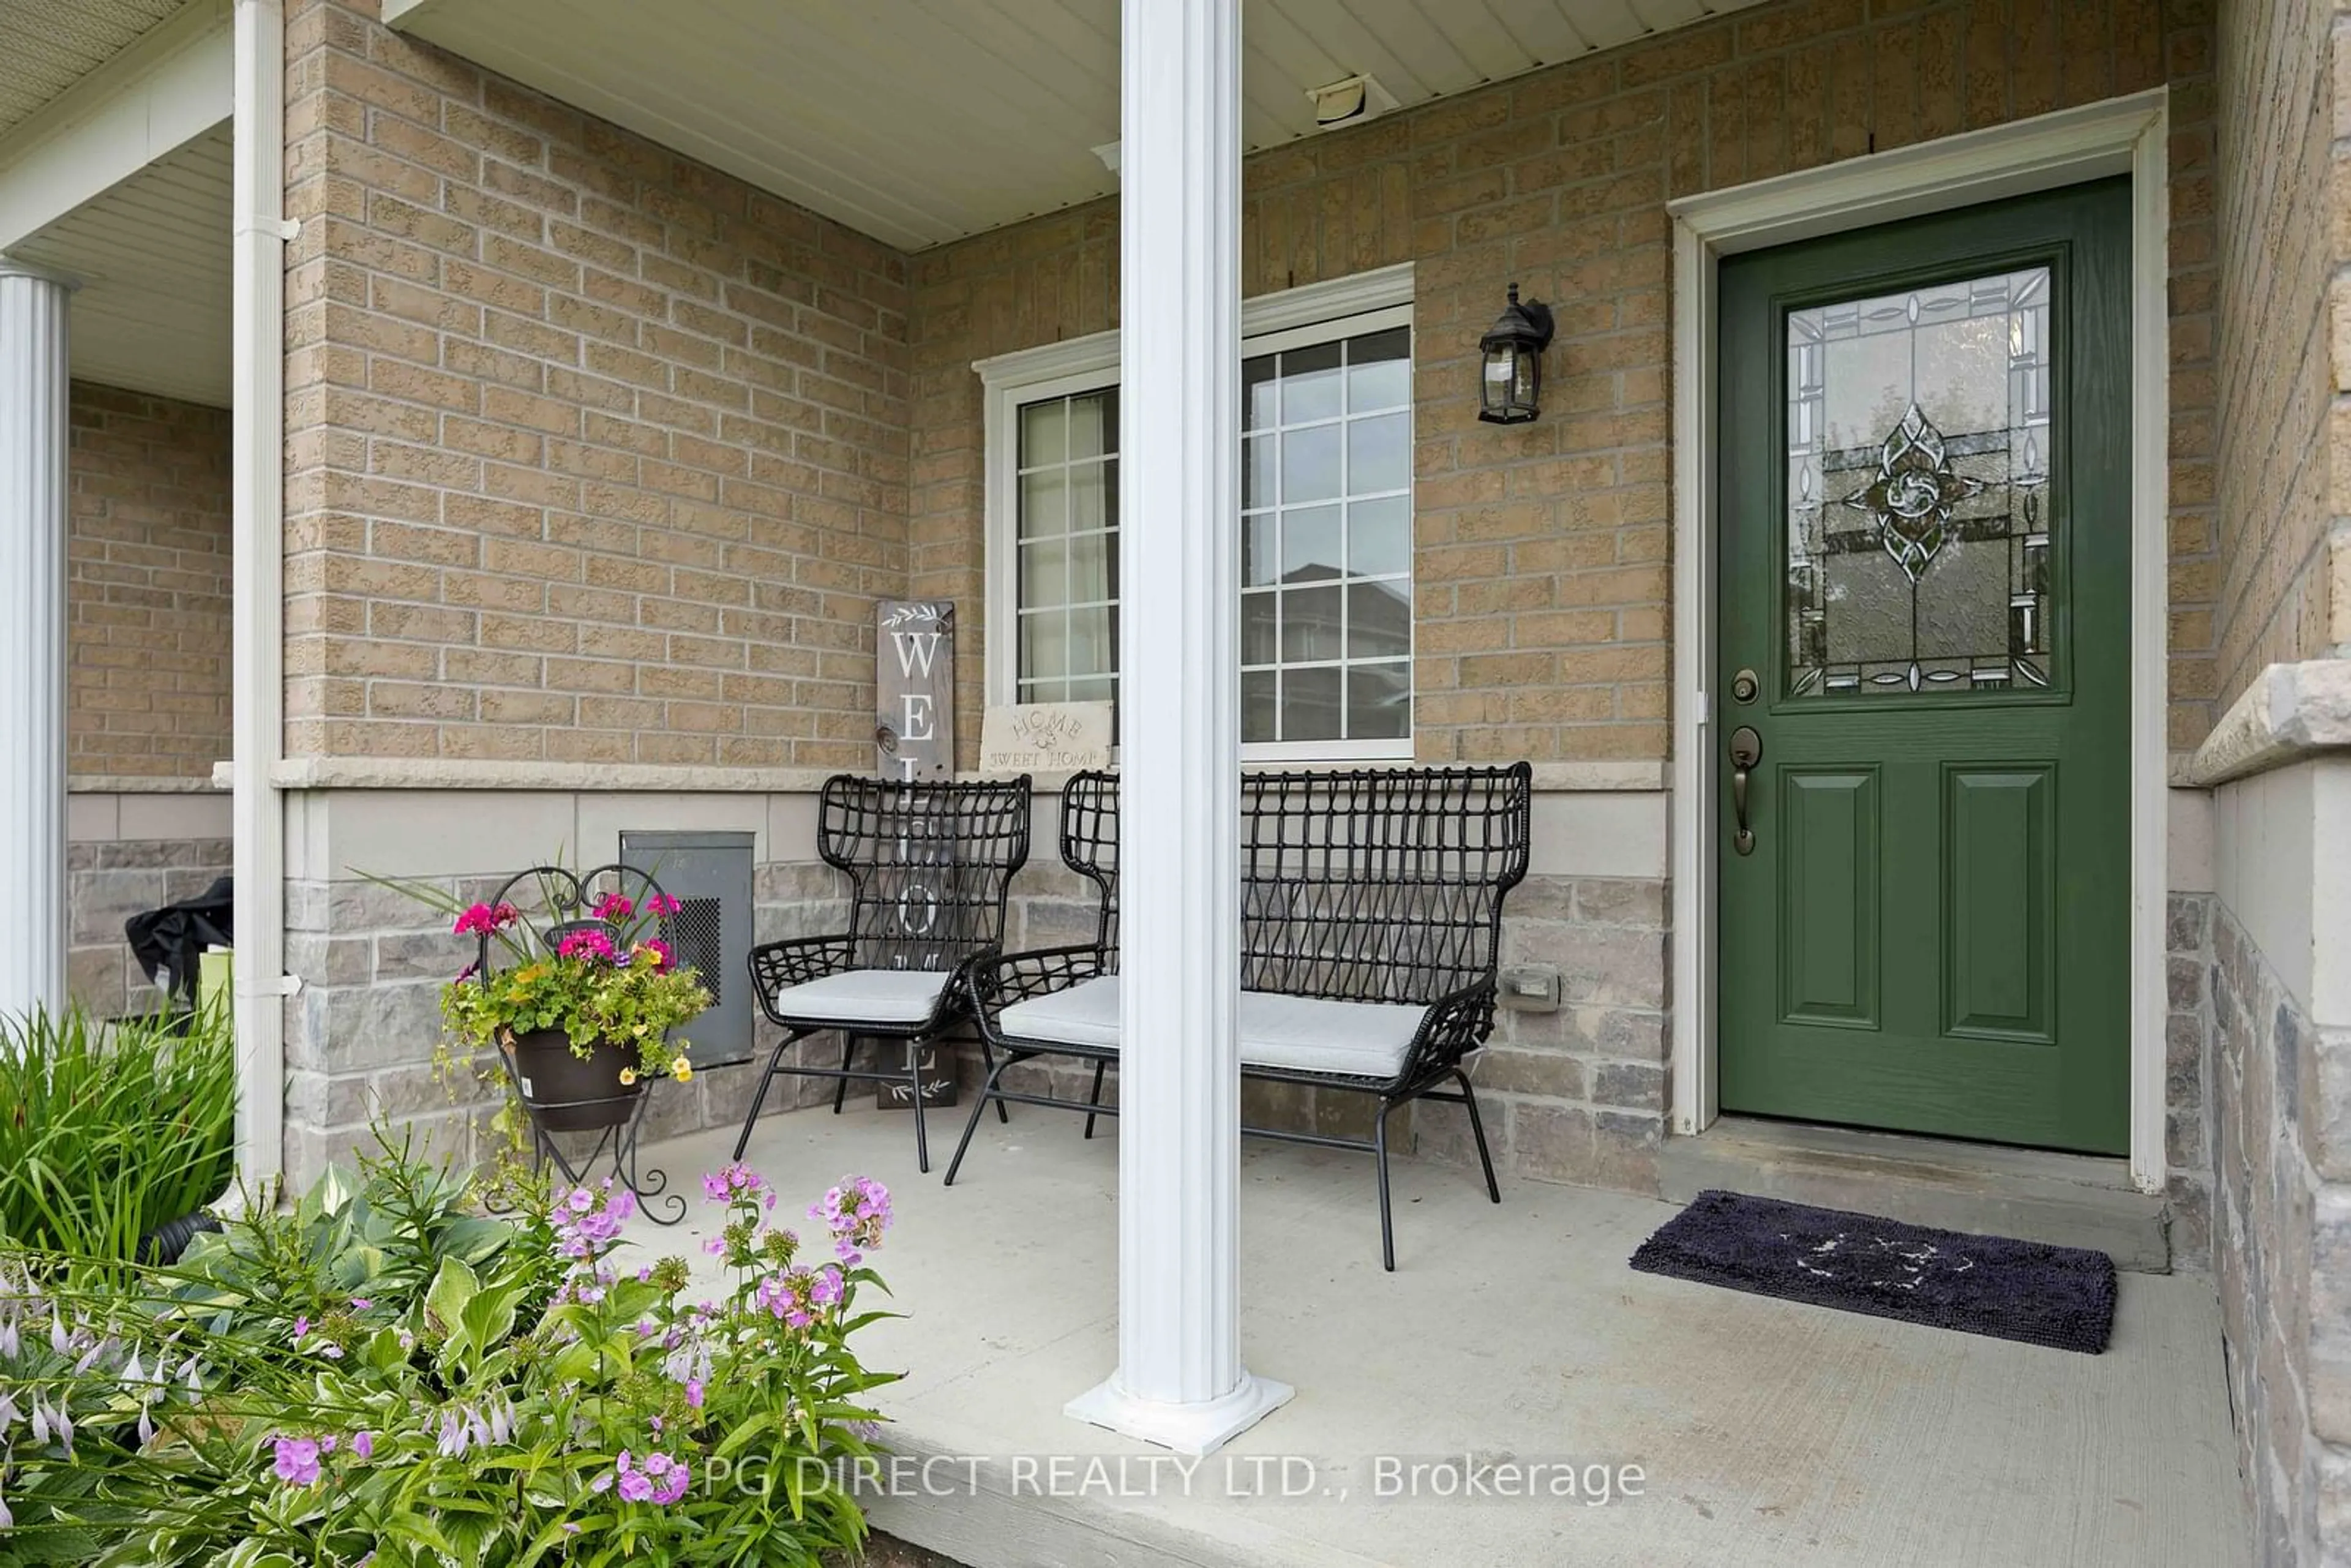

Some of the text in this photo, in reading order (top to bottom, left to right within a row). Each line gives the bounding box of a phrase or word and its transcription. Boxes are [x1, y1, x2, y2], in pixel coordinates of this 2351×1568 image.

[1013, 710, 1082, 740] HOME
[990, 751, 1097, 767] SWEET HOME
